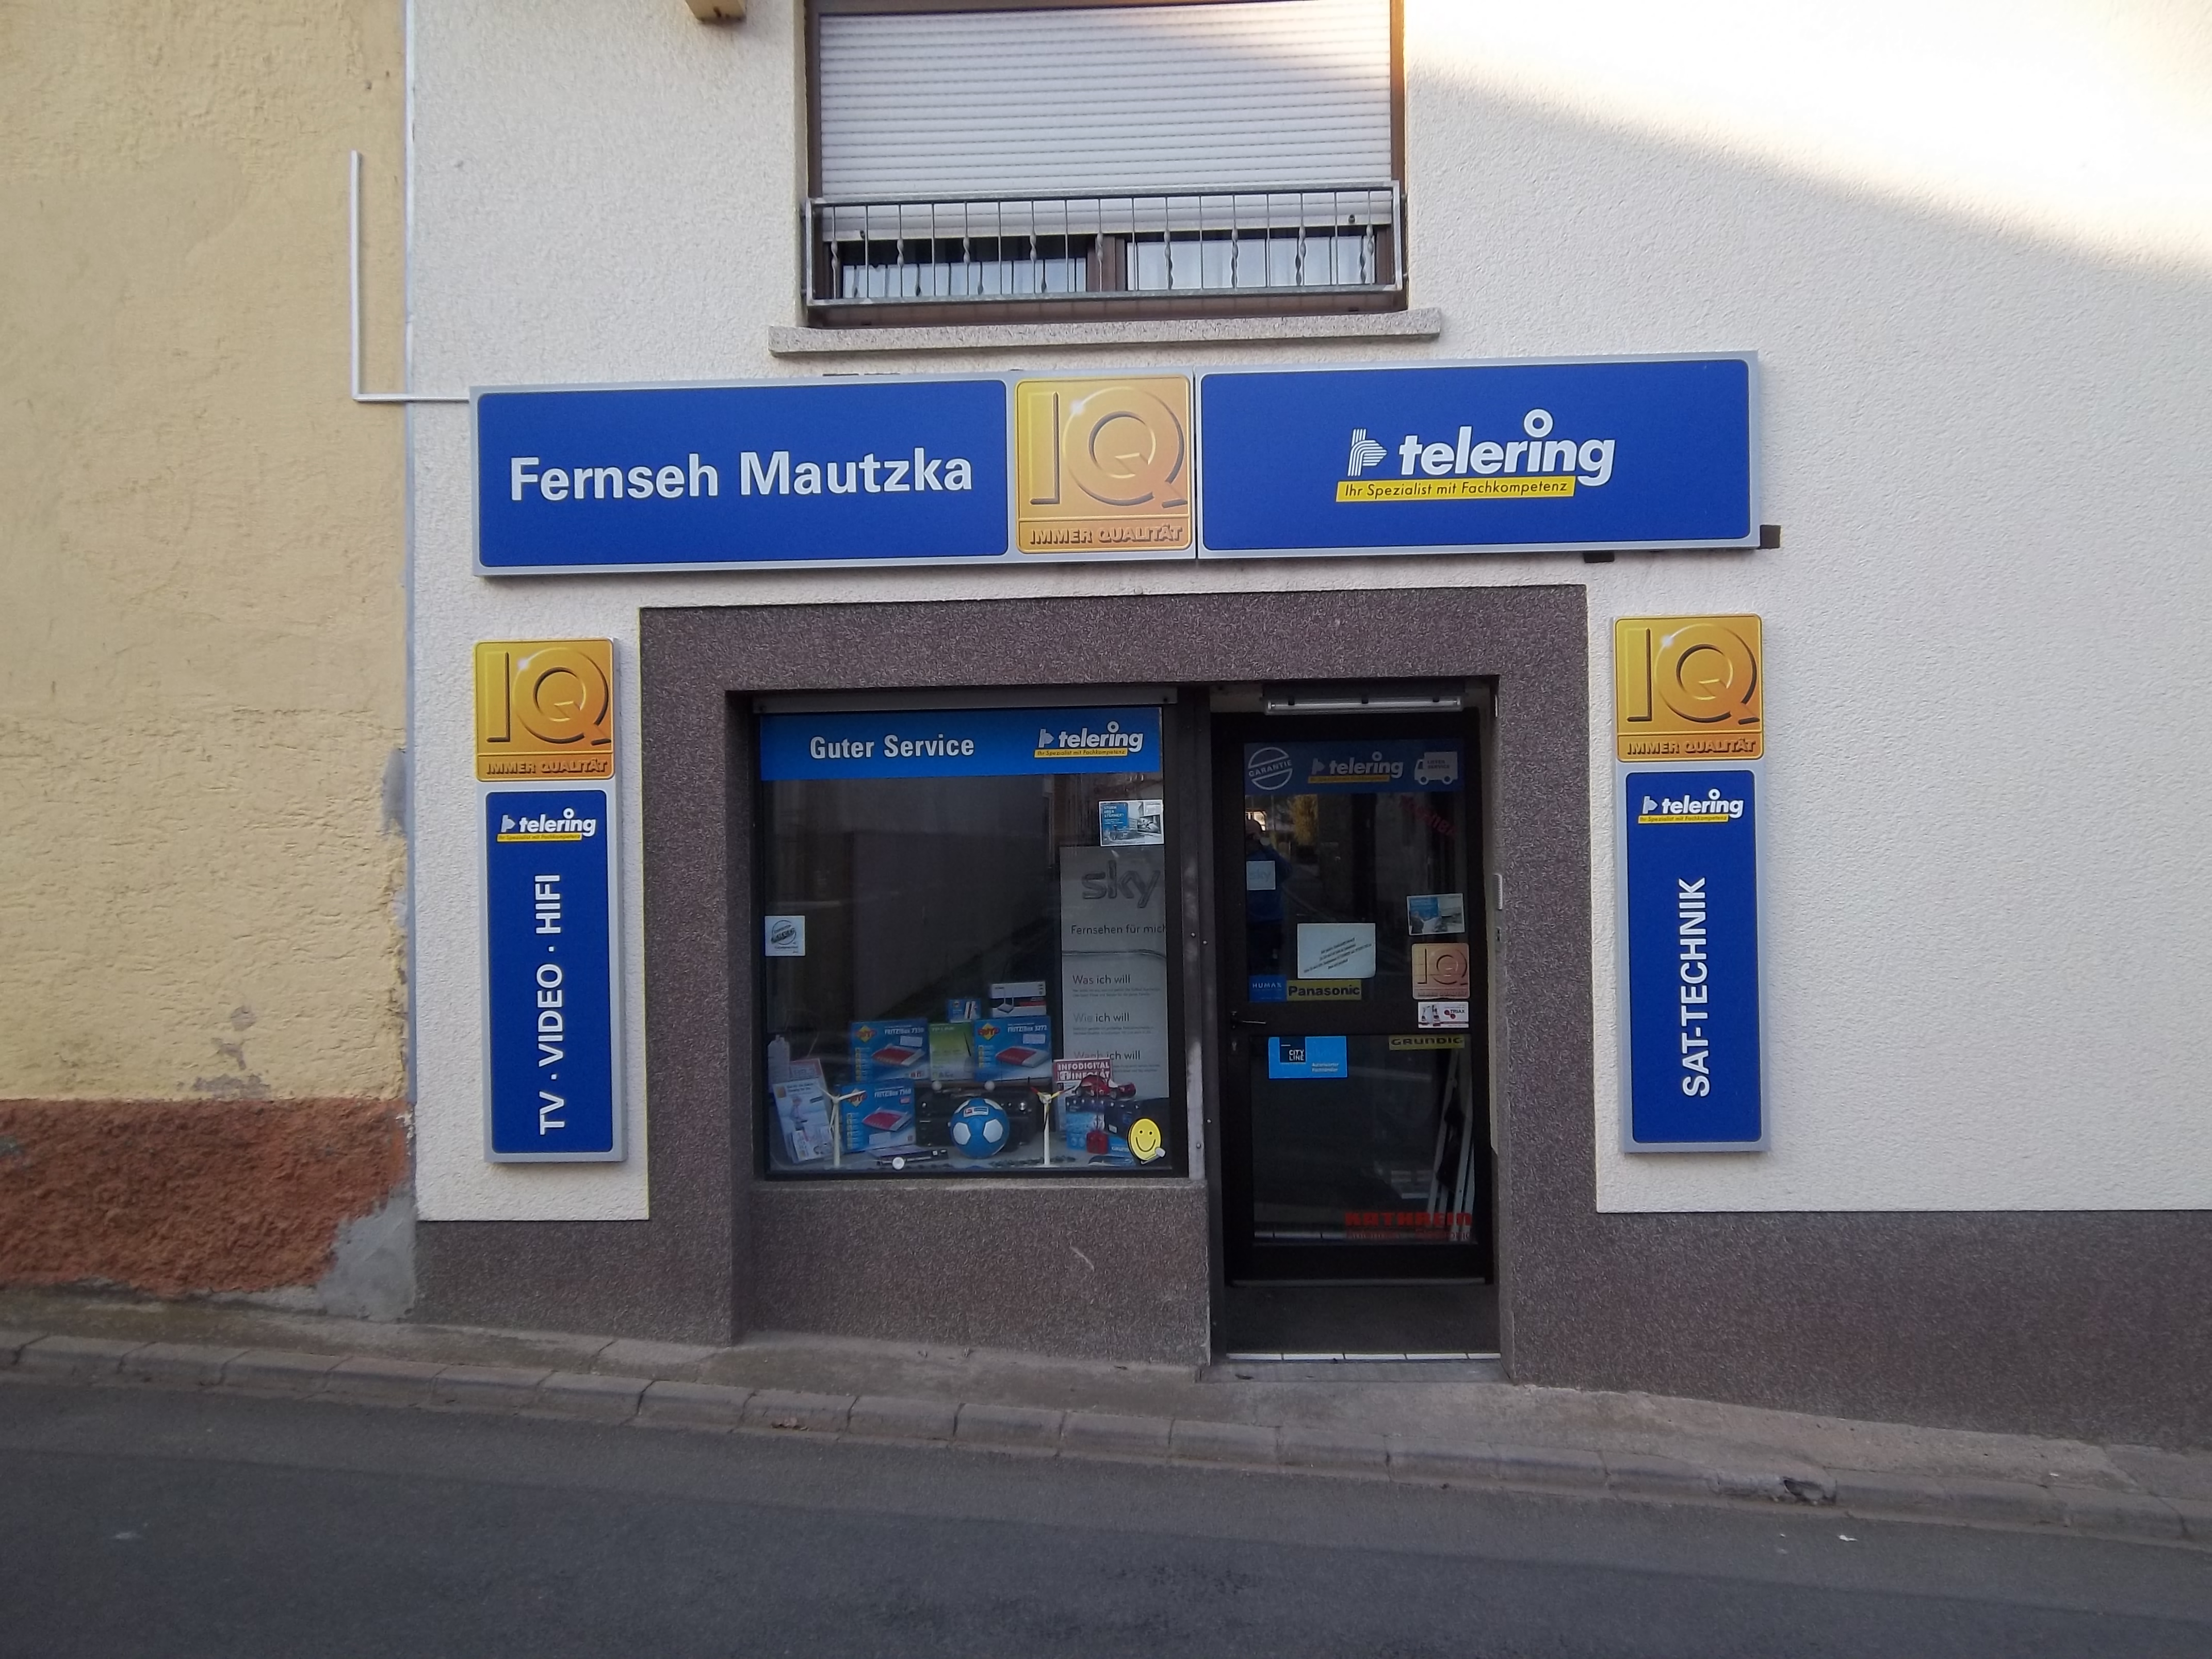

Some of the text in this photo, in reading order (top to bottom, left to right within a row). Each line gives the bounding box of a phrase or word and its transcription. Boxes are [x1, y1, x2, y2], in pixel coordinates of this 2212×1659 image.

[1028, 385, 1188, 508] IQ
[1399, 408, 1615, 486] telering
[510, 447, 972, 501] Fernseh Mautzka
[1344, 480, 1568, 499] Ihr Spezialist mit Fachkompetenz
[1030, 524, 1183, 544] IMMER QUALITÄT
[1625, 623, 1760, 725] IQ
[484, 646, 612, 745] IQ
[810, 734, 974, 759] Guter Service
[1059, 721, 1144, 753] telering
[1627, 738, 1755, 755] IMMER QUALITÄT
[486, 757, 608, 775] IMMER QUALITÄT
[1248, 759, 1292, 777] GARANTIE
[1329, 751, 1404, 778] telering
[1662, 788, 1744, 819] telering
[519, 808, 596, 837] telering
[1082, 859, 1161, 908] sky
[1071, 924, 1123, 934] Fernsehen
[1126, 924, 1140, 933] für
[1072, 974, 1131, 984] Was ich will
[1288, 984, 1360, 996] Panasonic
[1678, 877, 1710, 1097] SAT-TECHNIK
[534, 874, 565, 1136] TV VIDEO HIFI
[1073, 1012, 1129, 1022] Wie ich will
[1391, 1037, 1463, 1045] GRUNDIG
[1107, 1050, 1121, 1060] ich
[1125, 1050, 1141, 1060] will
[1058, 1062, 1110, 1071] INFODIGITAL
[1345, 1212, 1473, 1227] KATHREIN
